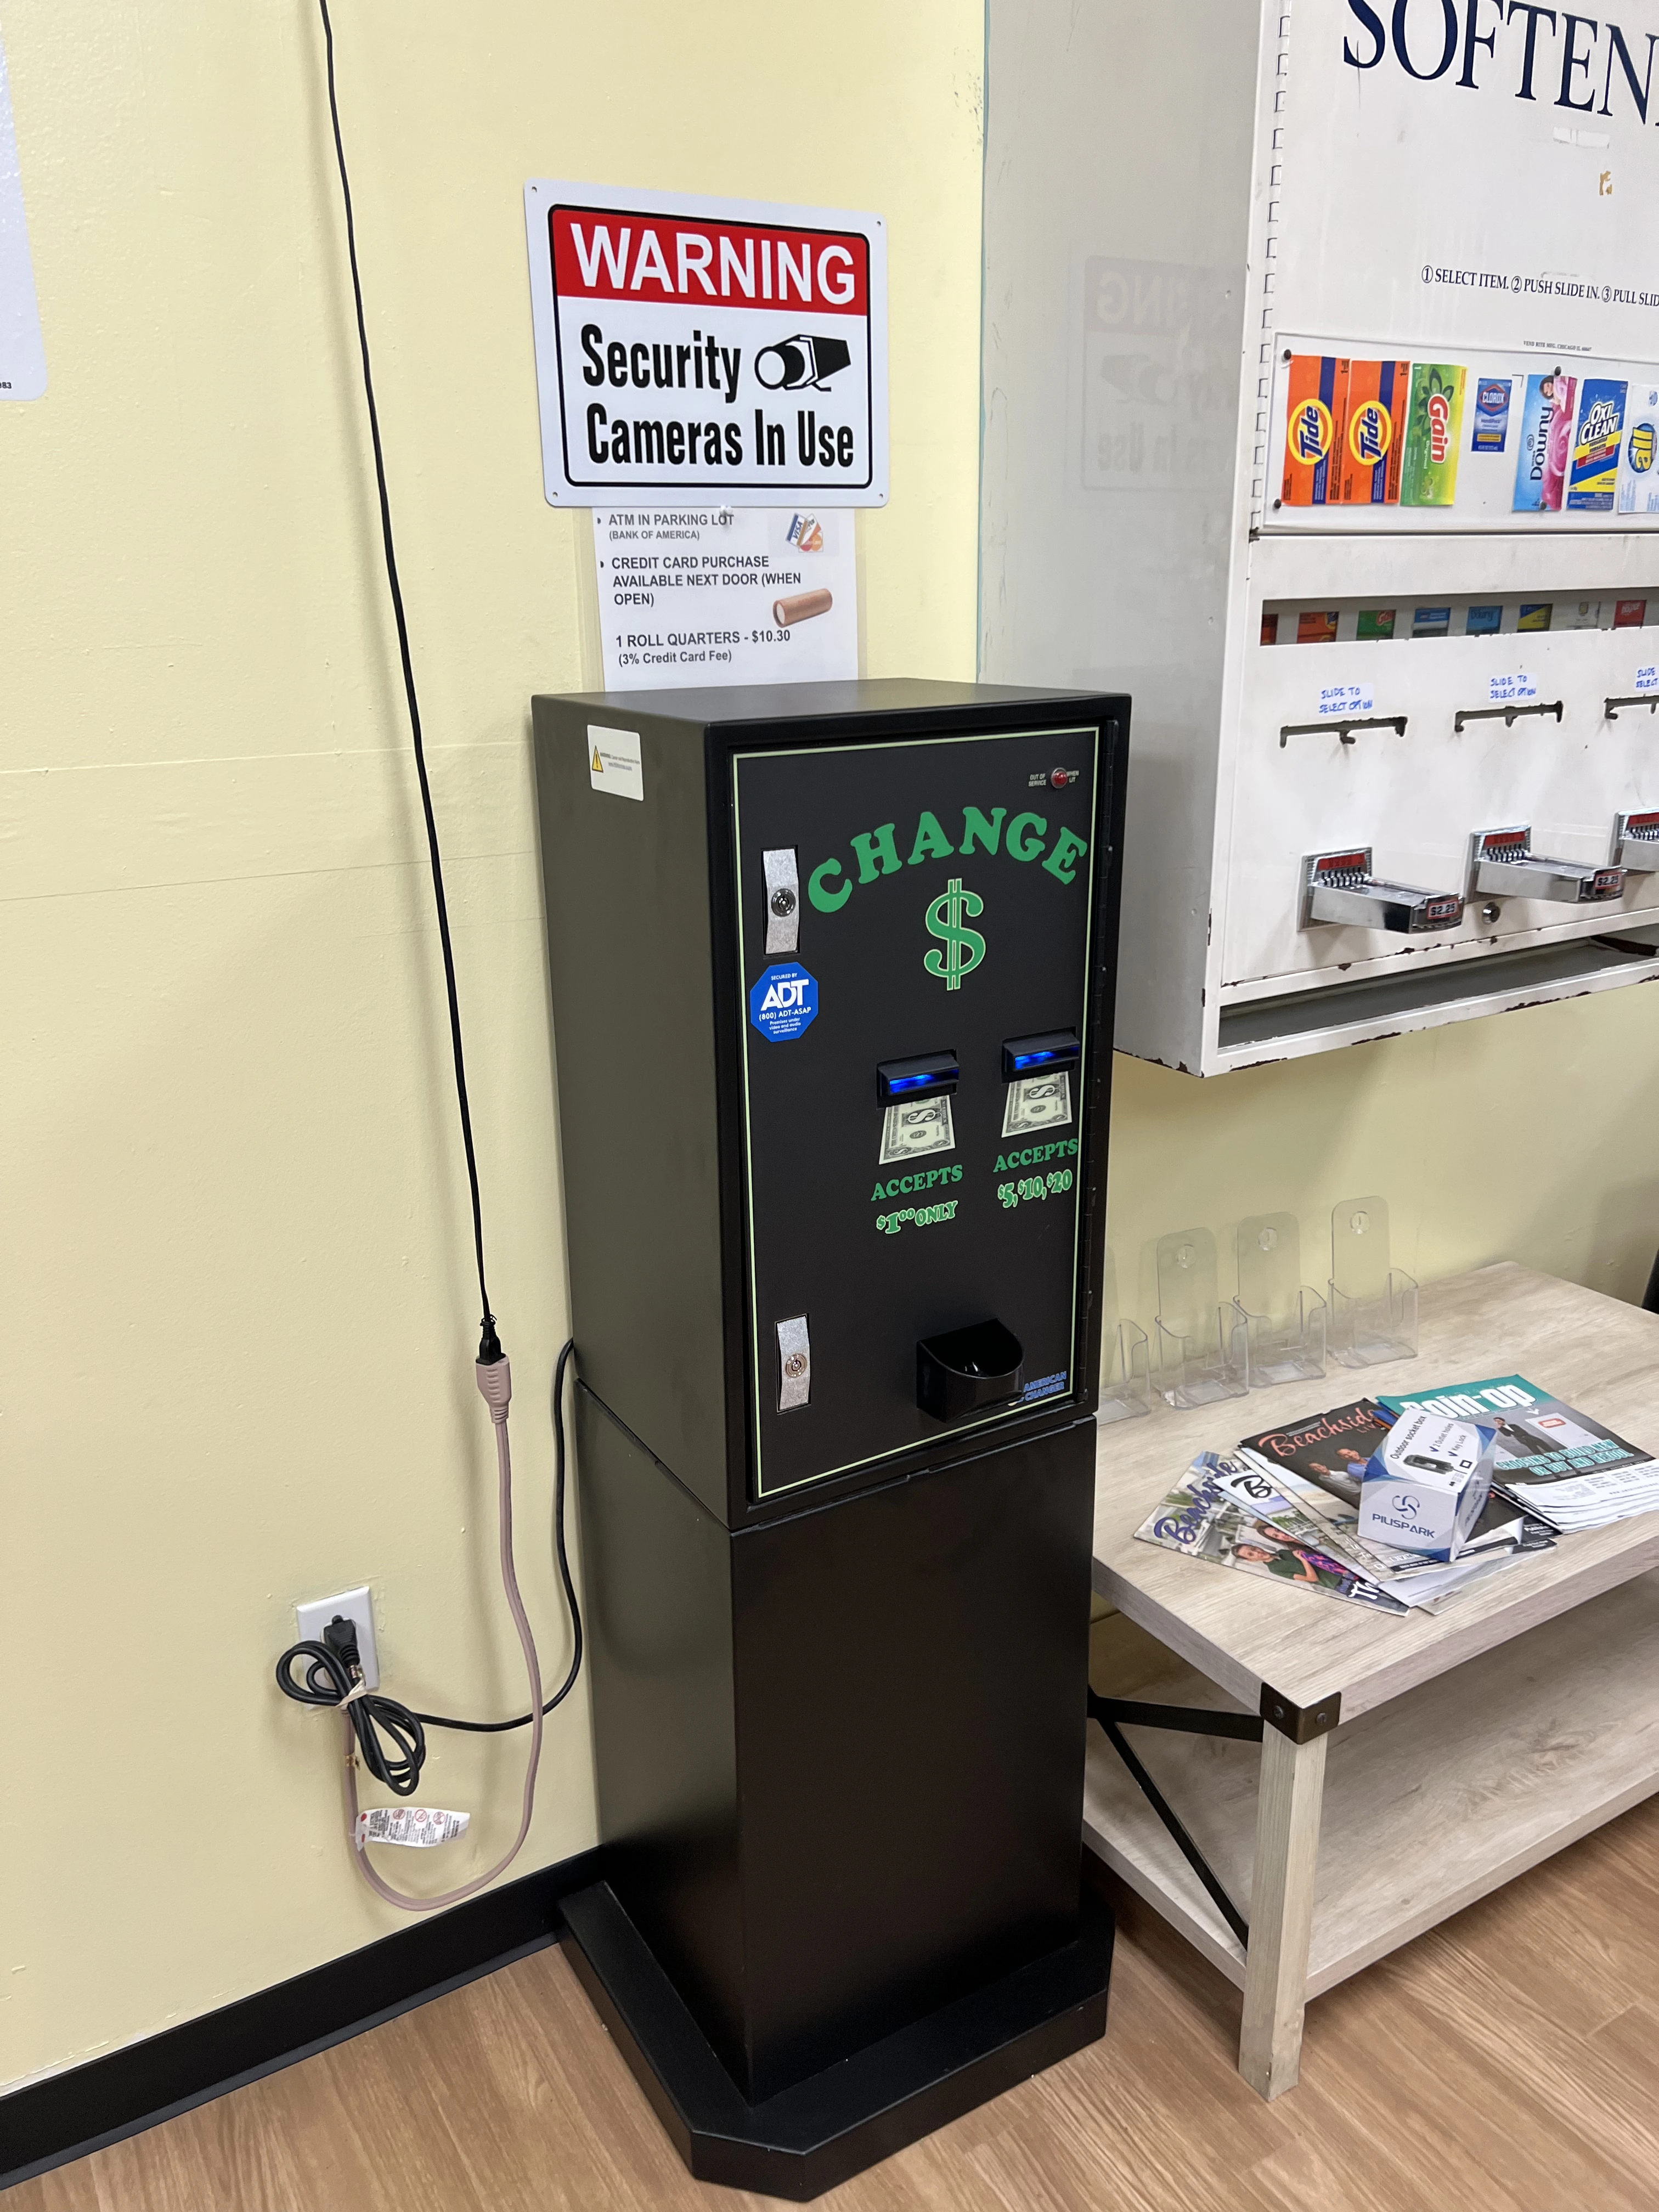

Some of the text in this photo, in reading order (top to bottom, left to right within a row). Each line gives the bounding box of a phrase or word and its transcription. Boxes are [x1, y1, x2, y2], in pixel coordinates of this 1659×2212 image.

[1344, 0, 1659, 127] SOFTEN
[570, 223, 855, 306] WARNING
[1435, 268, 1477, 286] SELECT
[1479, 273, 1509, 289] ITEM.
[1524, 279, 1553, 294] PUSH
[1555, 282, 1584, 297] SLIDE
[1586, 286, 1600, 299] IN.
[1613, 289, 1637, 303] PULL
[580, 324, 741, 403] Security
[1482, 391, 1504, 403] CLOROX
[1590, 402, 1614, 425] OXI
[586, 403, 854, 467] Cameras In Use
[1300, 405, 1324, 459] Tide
[1360, 407, 1383, 460] Tide
[1427, 393, 1449, 463] Gain
[1580, 414, 1619, 445] CLEAN
[1530, 407, 1554, 480] Downy
[1633, 427, 1653, 470] all
[609, 514, 734, 526] ATM IN PARKING LOT
[610, 530, 699, 540] (BANK OF AMERICA)
[612, 556, 769, 569] CREDIT CARD PURCHASE
[613, 573, 801, 587] AVAILABLE NEXT DOOR (WHEN
[614, 594, 654, 607] OPEN)
[616, 635, 622, 647] 1
[627, 634, 664, 647] ROLL
[667, 631, 740, 646] QUARTERS
[752, 630, 790, 644] $10.30
[618, 650, 732, 667] (3% Credit Card Fee)
[1321, 687, 1360, 699] SLIDE TO
[1489, 689, 1515, 699] SELECT
[1490, 675, 1527, 686] SLIDE TO
[1319, 702, 1346, 713] SELECT
[808, 807, 1087, 912] CHANGE
[1430, 904, 1455, 916] $2.25
[760, 979, 809, 1011] ADT
[759, 1007, 811, 1022] (800) ADT-ASAP
[993, 1138, 1078, 1172] ACCEPTS
[871, 1165, 963, 1201] ACCEPTS
[915, 1200, 958, 1227] ONLY
[1024, 1371, 1066, 1392] AMERICAN
[1025, 1381, 1064, 1401] CHANGER
[1390, 1415, 1426, 1459] Outdoor socket box
[1496, 1438, 1620, 1470] CHOOSING TO BUILD NEW
[1529, 1466, 1553, 1476] OR
[1544, 1460, 1573, 1473] BUY
[1567, 1457, 1595, 1469] AND
[1588, 1448, 1634, 1464] RETOOL
[1372, 1513, 1435, 1538] PILISPARK
